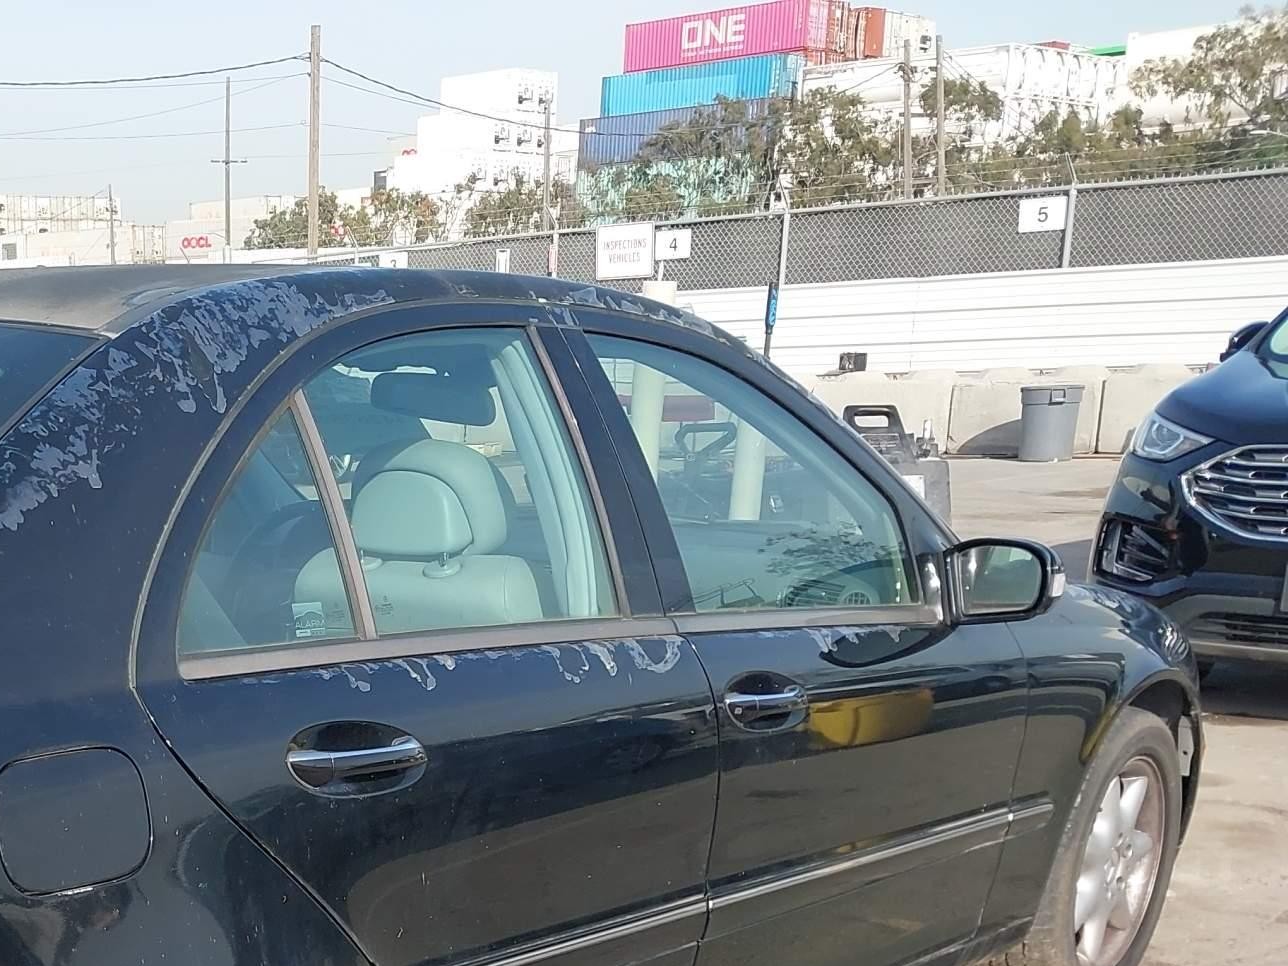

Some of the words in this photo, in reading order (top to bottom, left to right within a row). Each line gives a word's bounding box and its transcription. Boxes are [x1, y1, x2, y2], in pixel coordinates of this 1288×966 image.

[681, 13, 746, 50] ONE
[1038, 206, 1049, 223] 5
[182, 235, 212, 249] OOCL
[603, 238, 647, 251] INSPECTIONS
[669, 237, 678, 252] 4
[608, 252, 641, 264] VEHICLES
